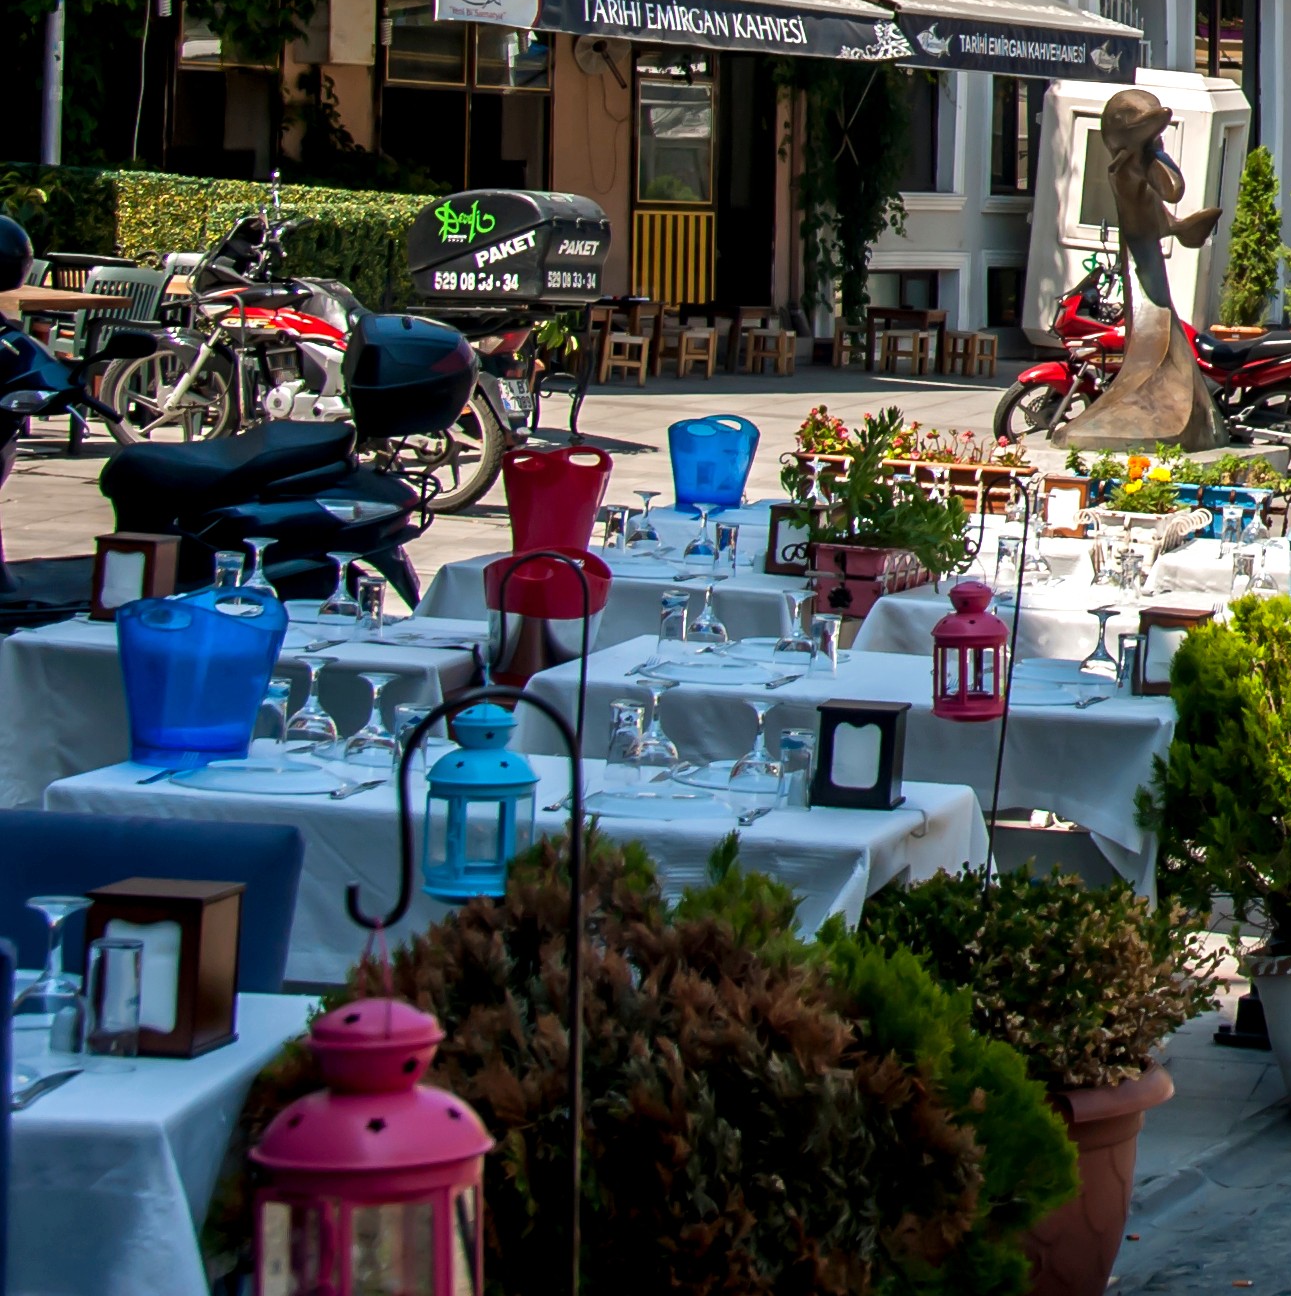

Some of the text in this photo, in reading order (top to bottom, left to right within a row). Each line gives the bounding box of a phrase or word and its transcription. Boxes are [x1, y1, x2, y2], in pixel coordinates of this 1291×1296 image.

[646, 0, 730, 37] EMİRGAN
[733, 15, 808, 44] KAHVESİ
[959, 32, 987, 54] TARİHİ
[988, 35, 1028, 58] EMİRGAN
[475, 230, 536, 268] PAKET
[558, 239, 600, 256] PAKET
[434, 271, 458, 291] 529
[460, 271, 476, 291] 08
[502, 273, 519, 292] 34
[547, 271, 562, 289] 529
[562, 271, 571, 289] 08
[572, 271, 582, 289] 33
[586, 273, 597, 289] 34
